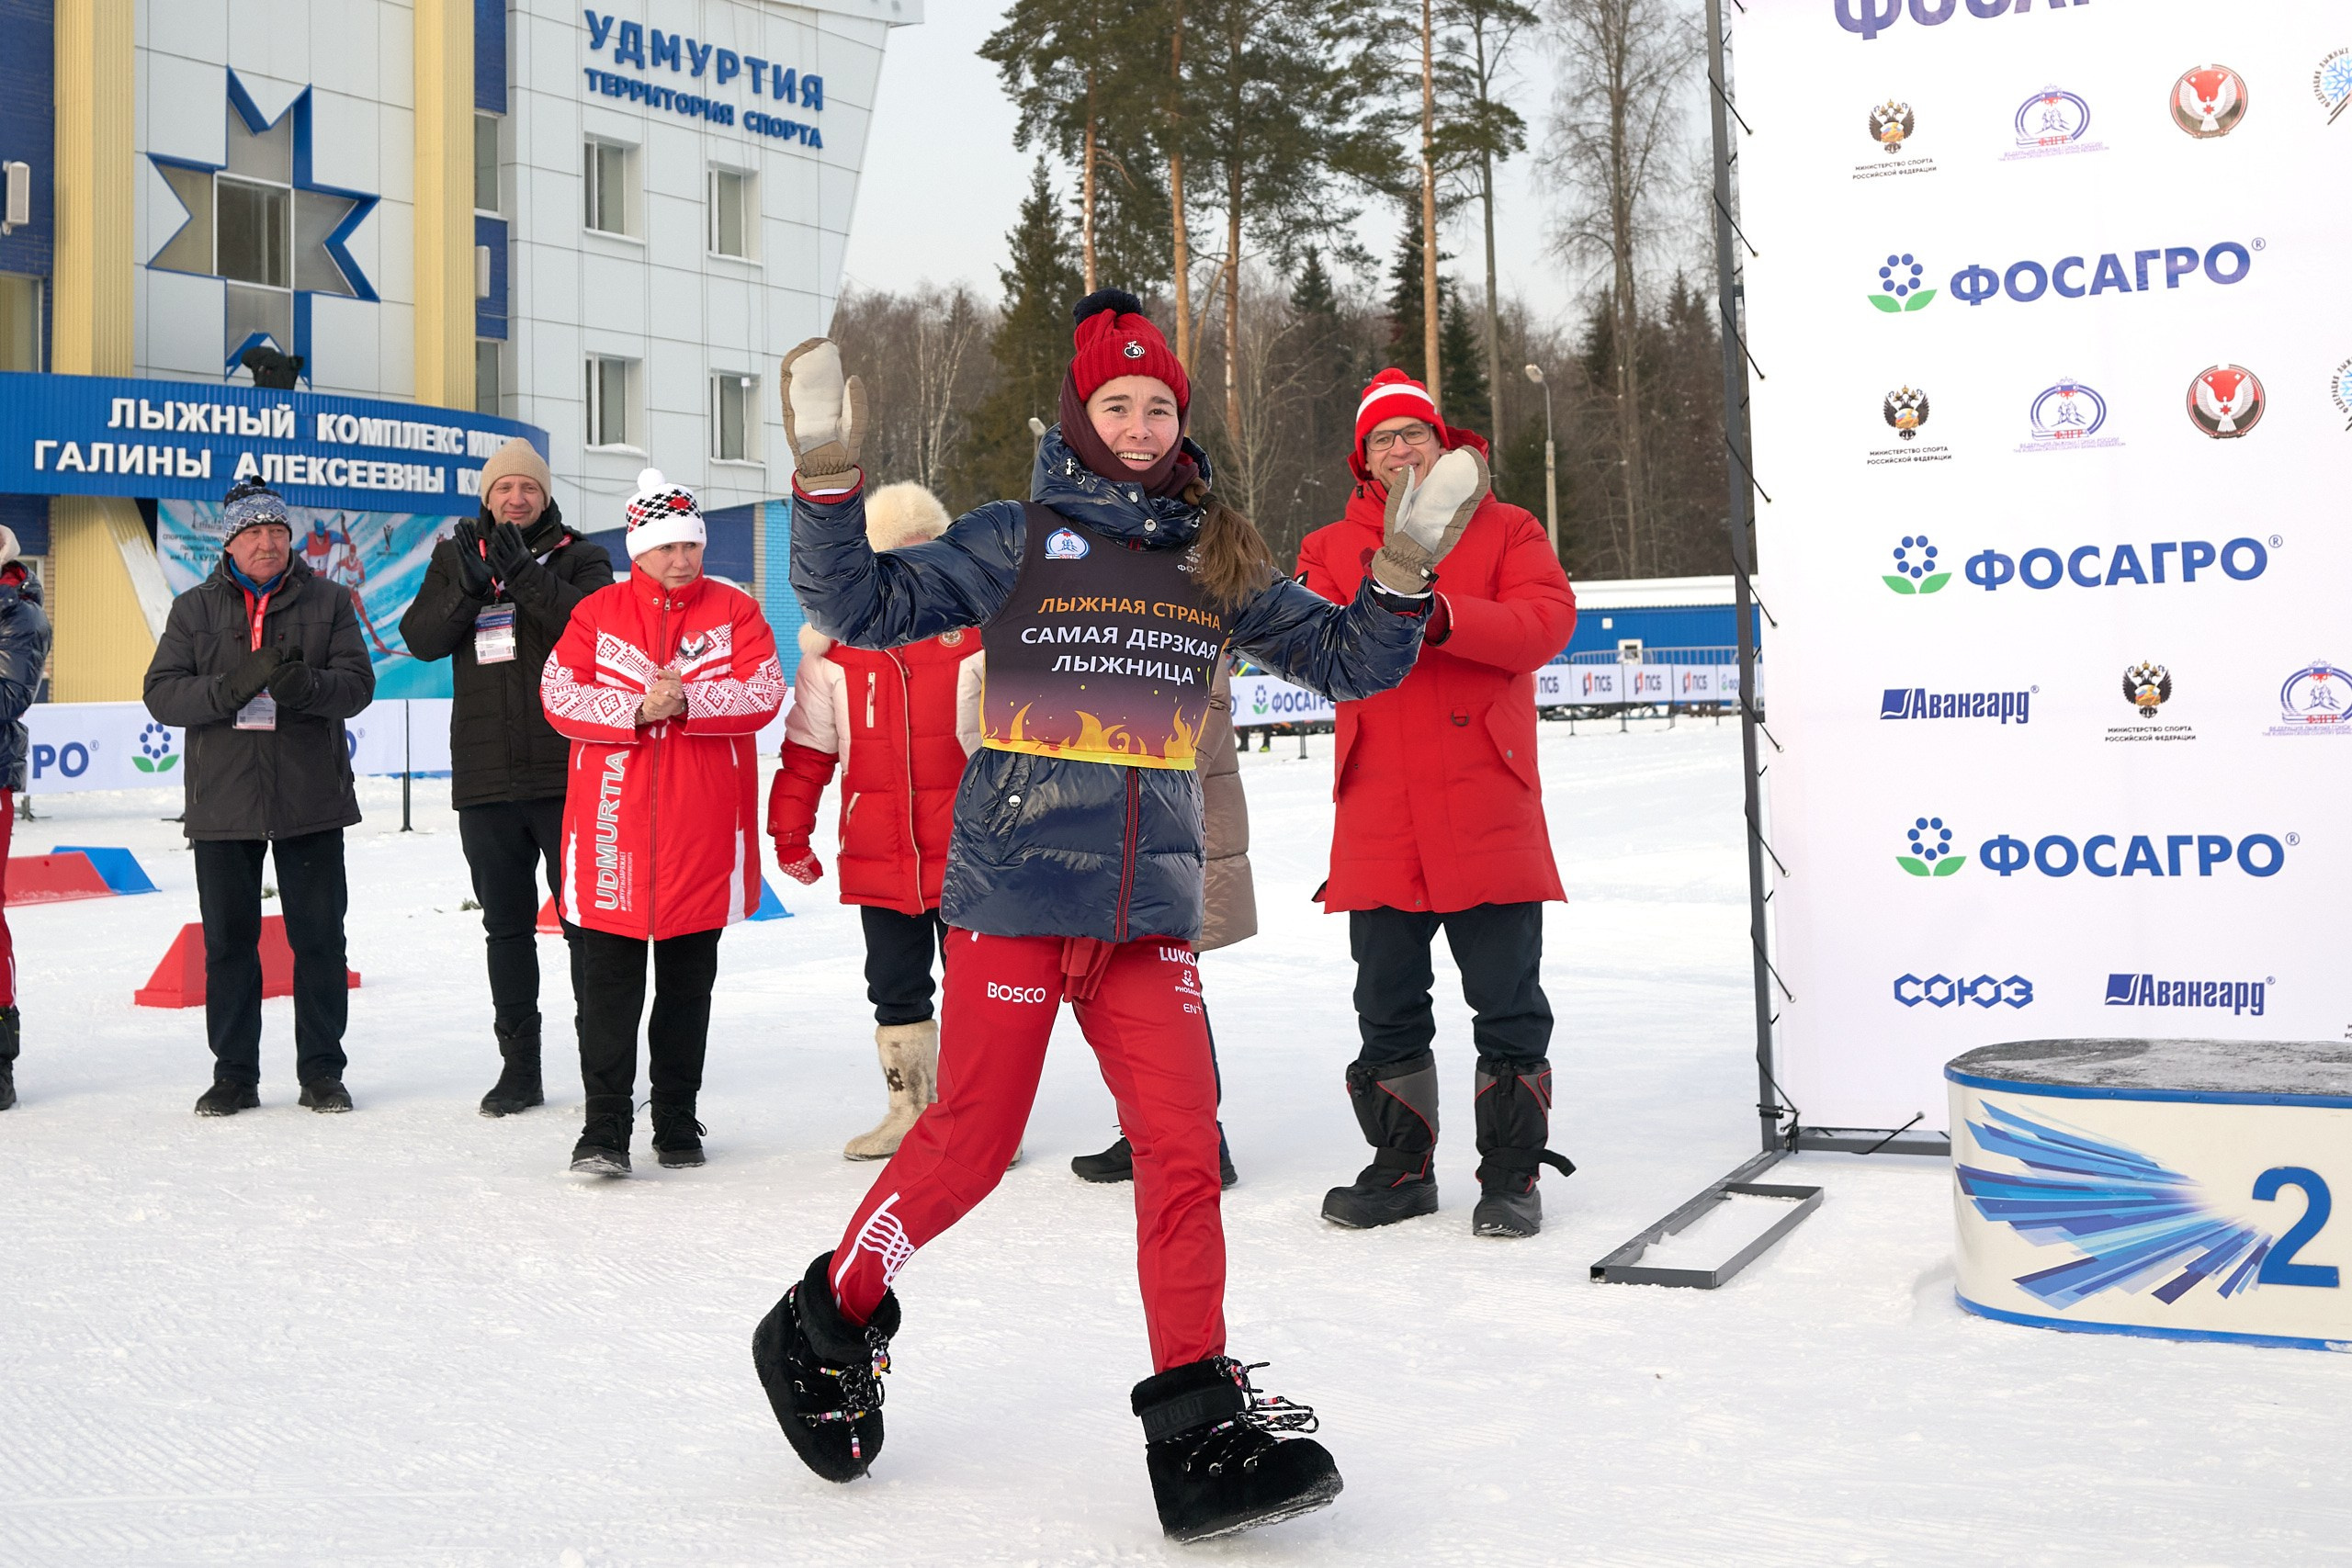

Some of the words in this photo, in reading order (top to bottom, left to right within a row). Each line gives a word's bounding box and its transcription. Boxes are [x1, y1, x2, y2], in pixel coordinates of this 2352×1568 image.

[584, 9, 823, 111] УДМУРТИЯ
[584, 67, 734, 126] ТЕРРИТОРИЯ
[743, 109, 823, 149] СПОРТА
[1852, 169, 1897, 179] РОССИЙСКОЙ
[1898, 166, 1937, 175] ФЕДЕРАЦИИ
[1855, 161, 1905, 171] МИНИСТЕРСТВО
[1907, 158, 1933, 166] СПОРТА
[107, 398, 295, 439] ЛЫЖНЫЙ
[317, 412, 464, 455] КОМПЛЕКС
[1867, 455, 1911, 465] РОССИЙСКОЙ
[1913, 454, 1952, 462] ФЕДЕРАЦИИ
[1870, 447, 1920, 456] МИНИСТЕРСТВО
[34, 440, 211, 479] ГАЛИНЫ
[232, 451, 445, 493] АЛЕКСЕЕВНЫ
[458, 468, 482, 496] КУ
[1038, 597, 1146, 615] ЛЫЖНАЯ
[1152, 602, 1221, 631] СТРАНА
[1021, 626, 1119, 644] САМАЯ
[1125, 628, 1217, 660] ДЕРЗКАЯ
[1051, 655, 1194, 685] ЛЫЖНИЦА
[1645, 673, 1662, 690] ПСБ
[1692, 673, 1707, 690] ПСБ
[1540, 676, 1559, 694] ПСБ
[1594, 675, 1612, 692] ПСБ
[594, 750, 629, 910] UDMURTIA
[1159, 947, 1196, 966] LUKO
[987, 981, 1046, 1003] BOSCO
[1894, 973, 2033, 1009] СОЮЗ
[2252, 1166, 2340, 1288] 2
